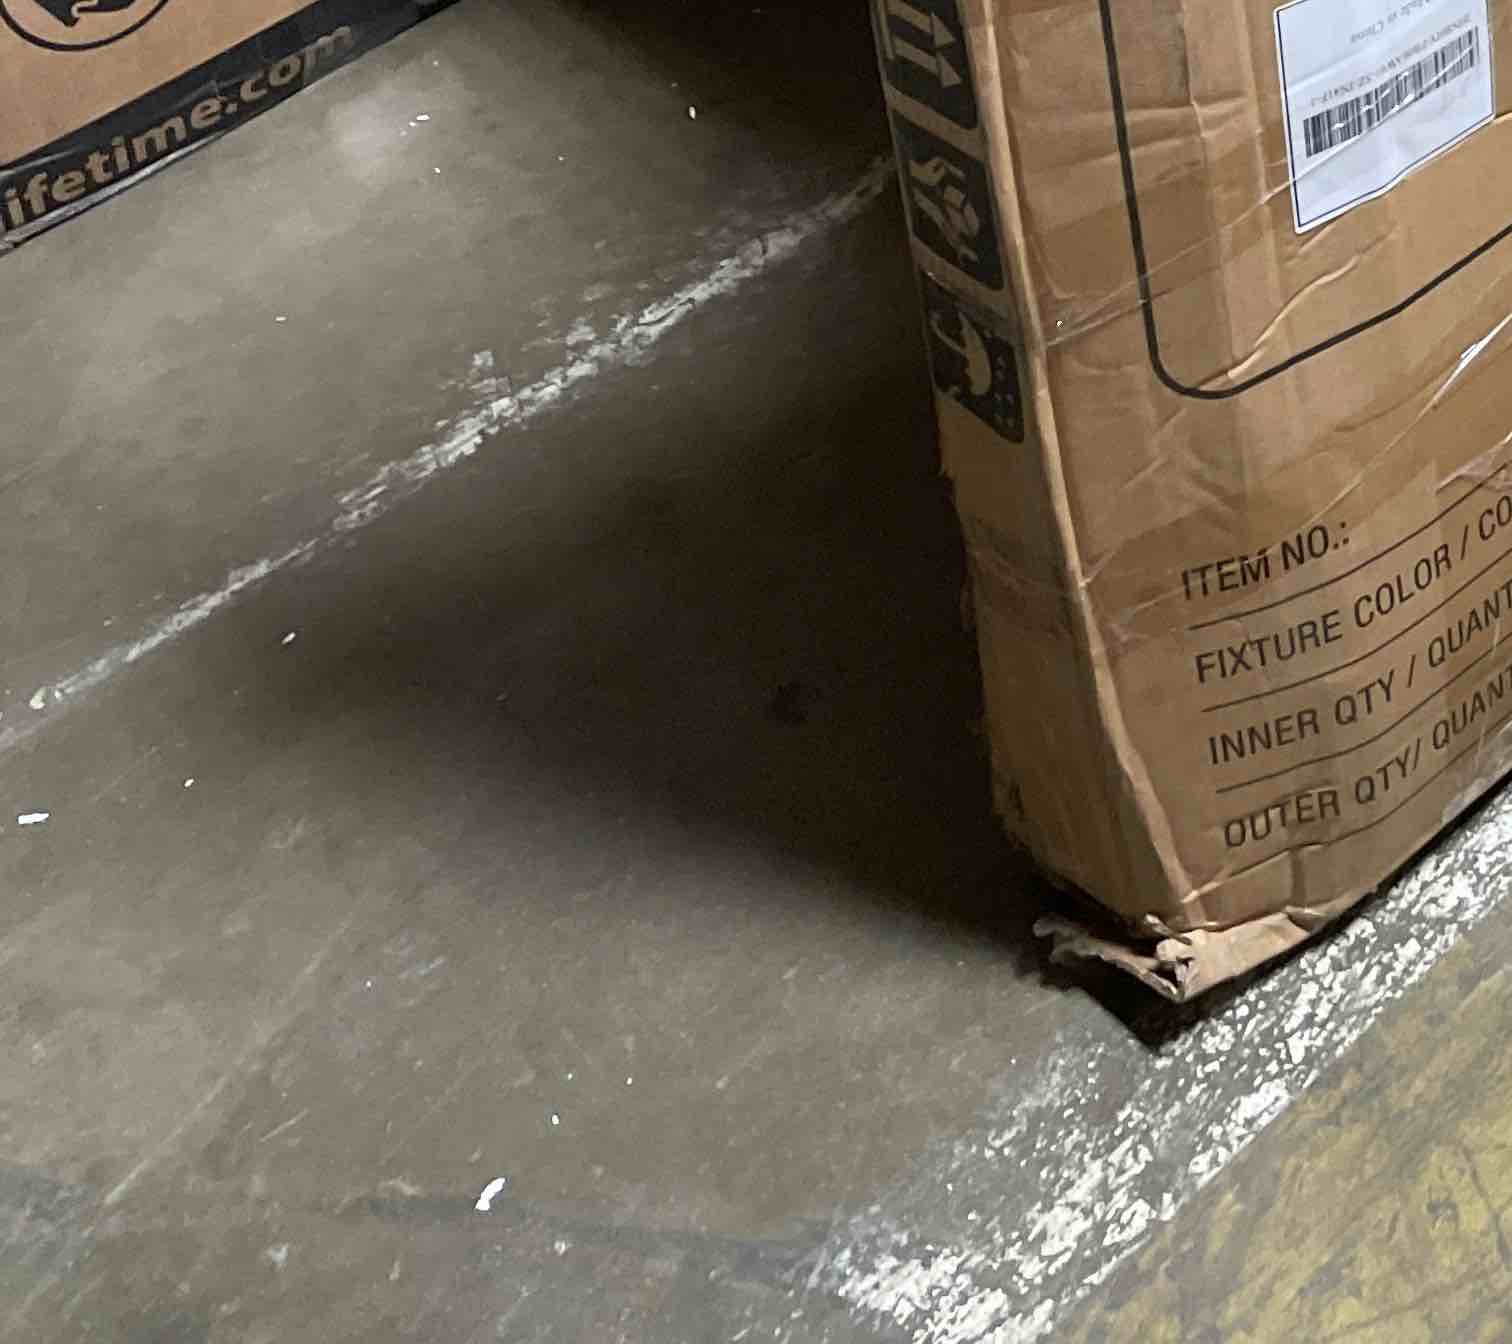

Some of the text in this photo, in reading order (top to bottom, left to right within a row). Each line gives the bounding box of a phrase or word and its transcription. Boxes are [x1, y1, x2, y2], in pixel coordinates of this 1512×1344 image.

[1181, 520, 1352, 602] ITEM NO.:
[1195, 608, 1344, 684] FIXTURE
[1352, 542, 1453, 629] COLOR
[1459, 524, 1471, 561] /
[1208, 707, 1321, 766] INNER
[1334, 668, 1396, 727] QTY
[1406, 653, 1418, 689] /
[1223, 788, 1342, 849] OUTER
[1354, 737, 1421, 807] QTY/
